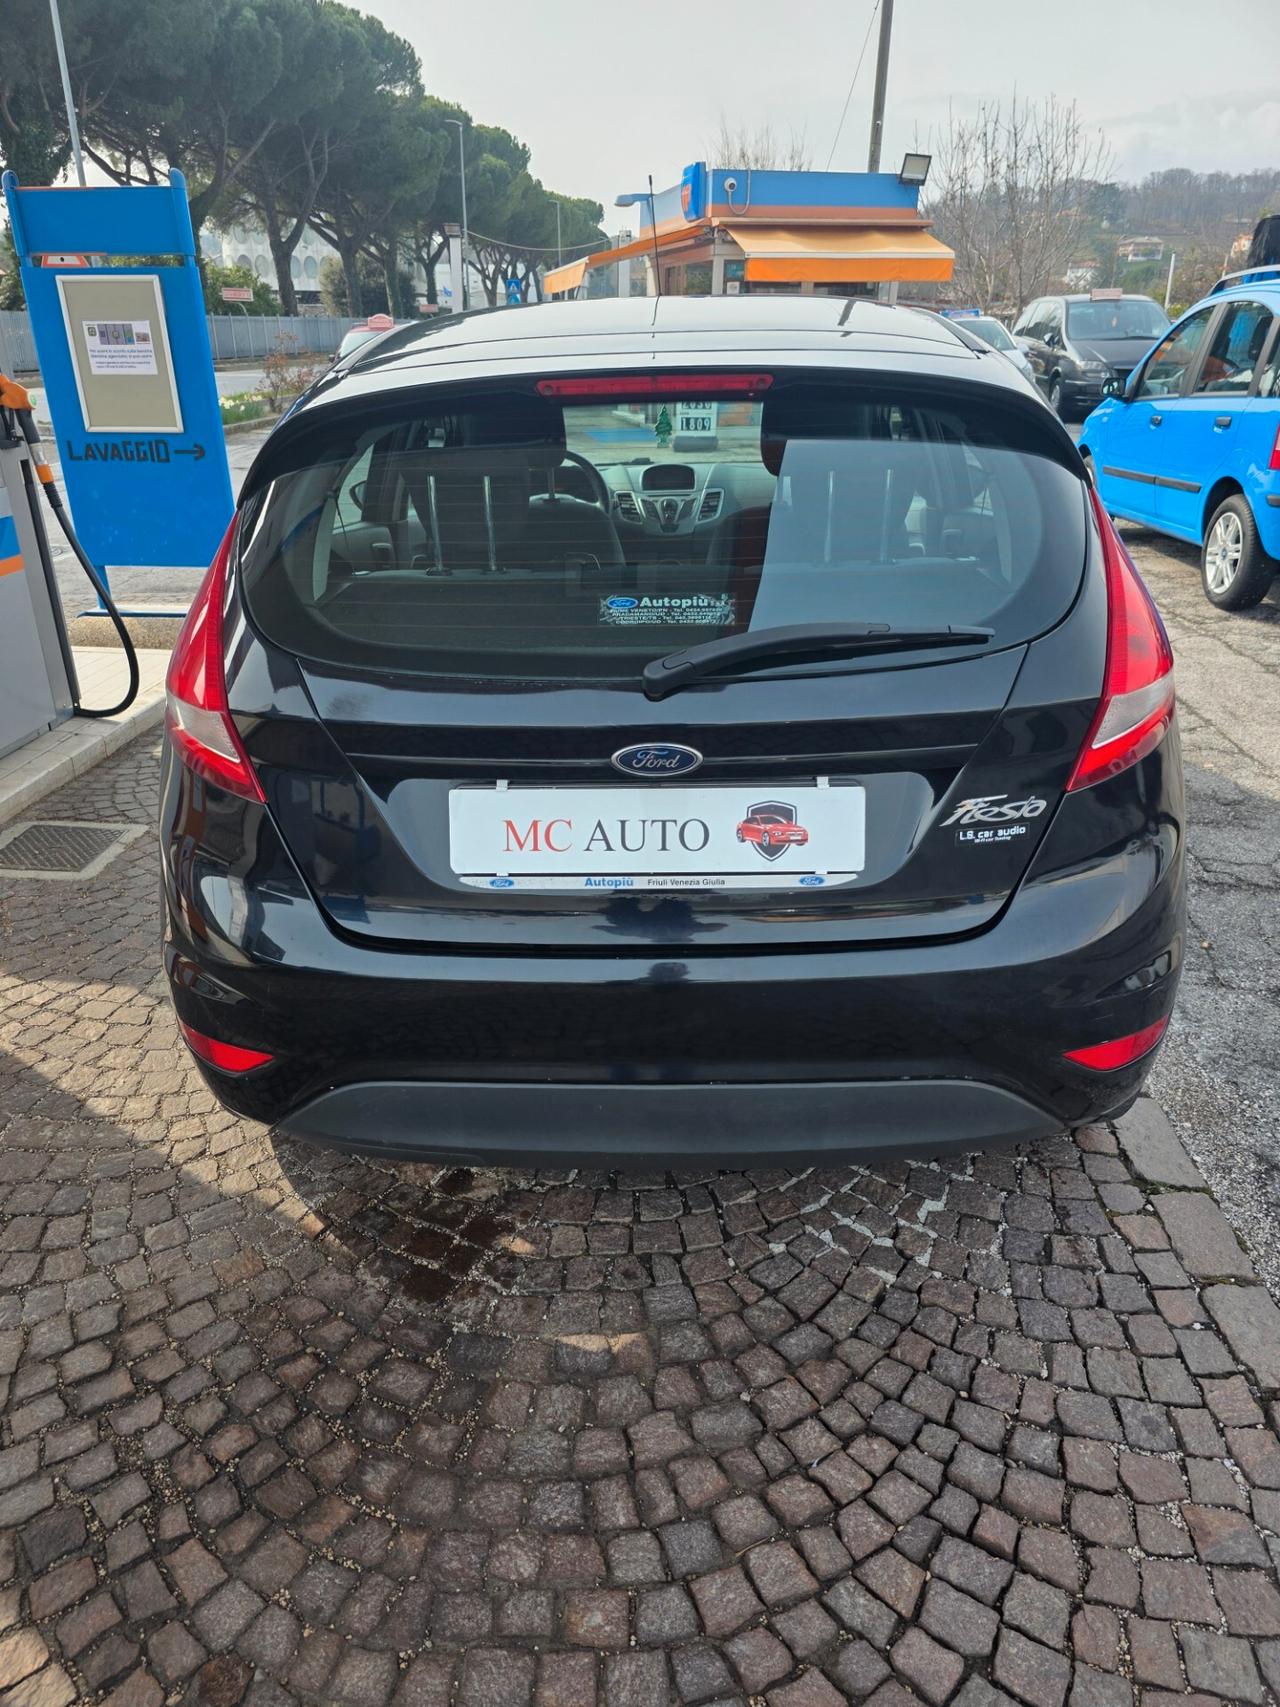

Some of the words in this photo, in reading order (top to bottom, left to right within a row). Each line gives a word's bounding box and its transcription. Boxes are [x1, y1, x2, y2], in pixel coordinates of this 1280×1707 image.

[682, 418, 710, 430] 1809
[66, 440, 171, 463] LAVAGGIO
[640, 597, 708, 608] Autopiù
[632, 750, 681, 768] Ford
[940, 794, 1047, 826] Fiesta
[502, 819, 573, 852] MC
[584, 818, 710, 852] AUTO
[997, 826, 1026, 836] audio
[584, 877, 634, 888] Autopiù
[647, 878, 668, 886] Friuli
[670, 878, 700, 886] Venezia
